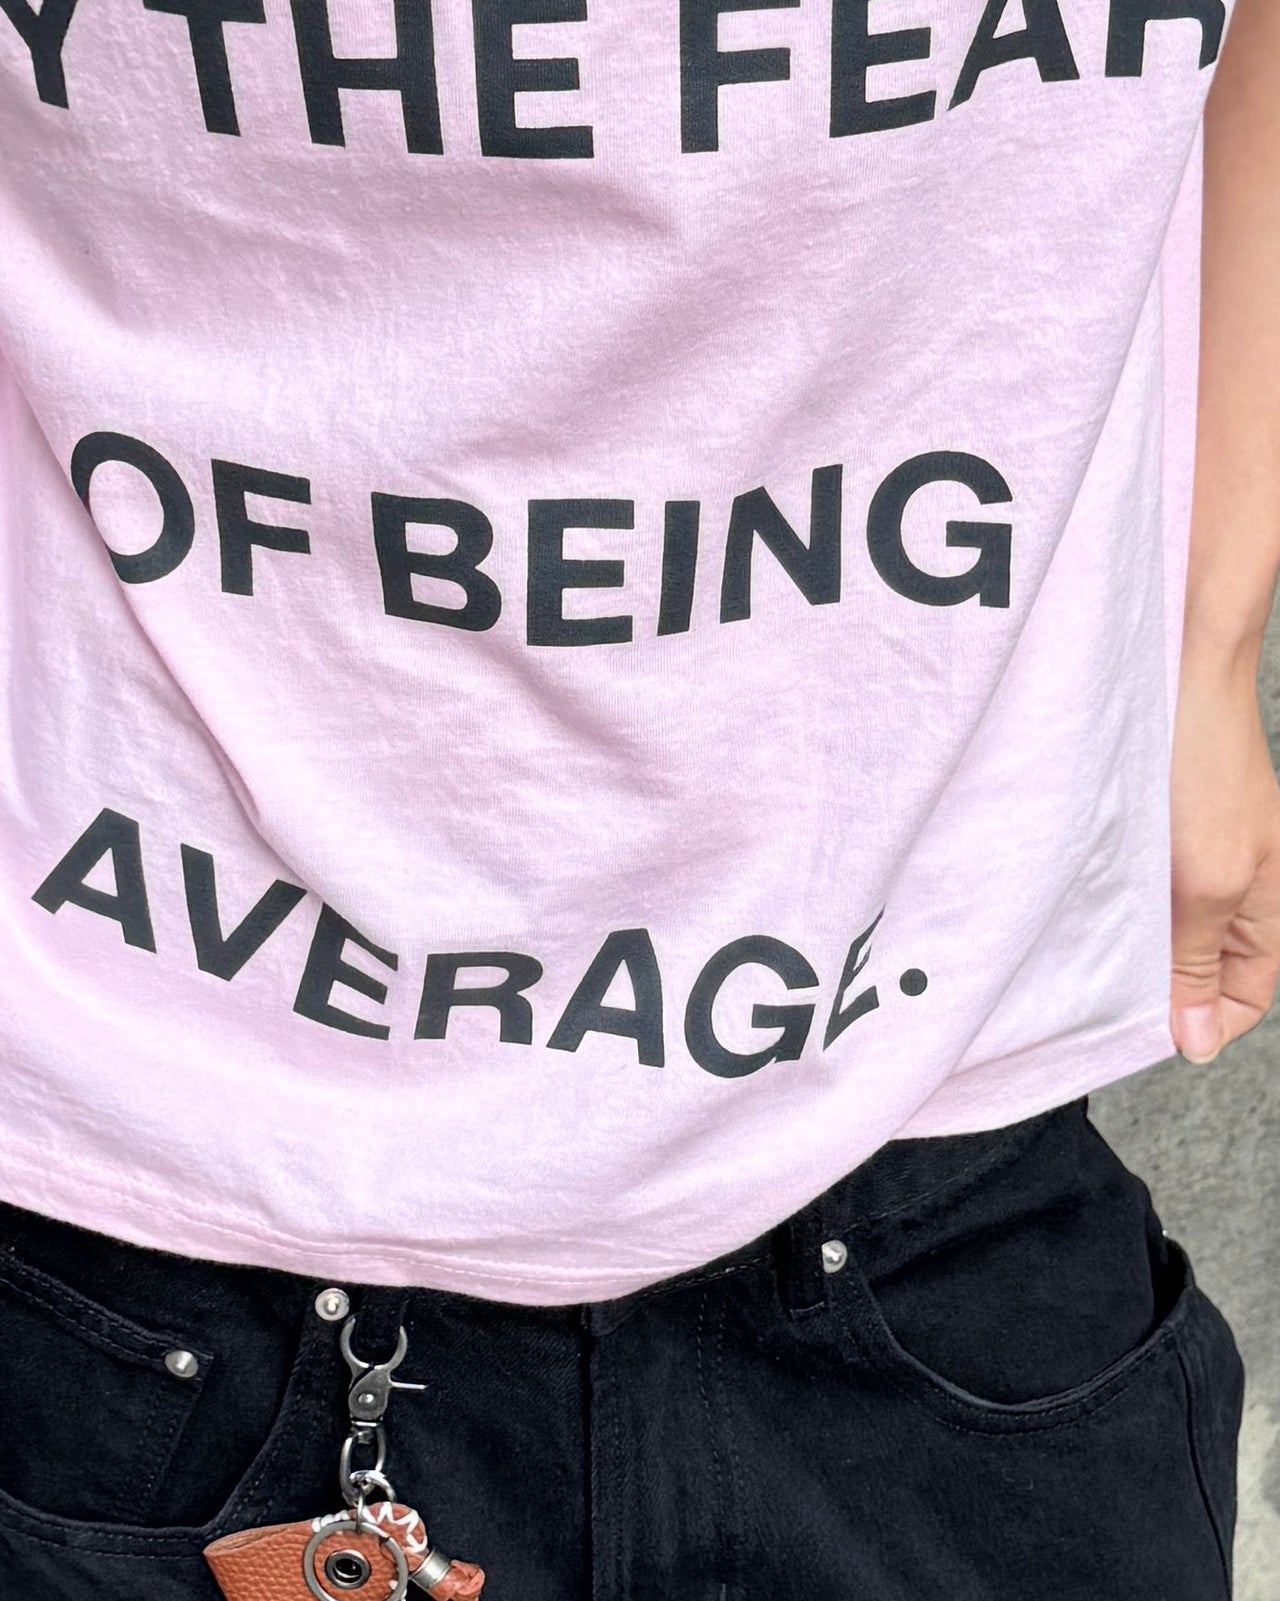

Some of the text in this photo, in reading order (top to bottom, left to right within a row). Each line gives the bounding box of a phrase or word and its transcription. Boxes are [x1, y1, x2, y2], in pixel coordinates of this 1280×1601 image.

[69, 431, 1014, 648] OF BEING
[31, 807, 930, 1080] AVERAGE.
